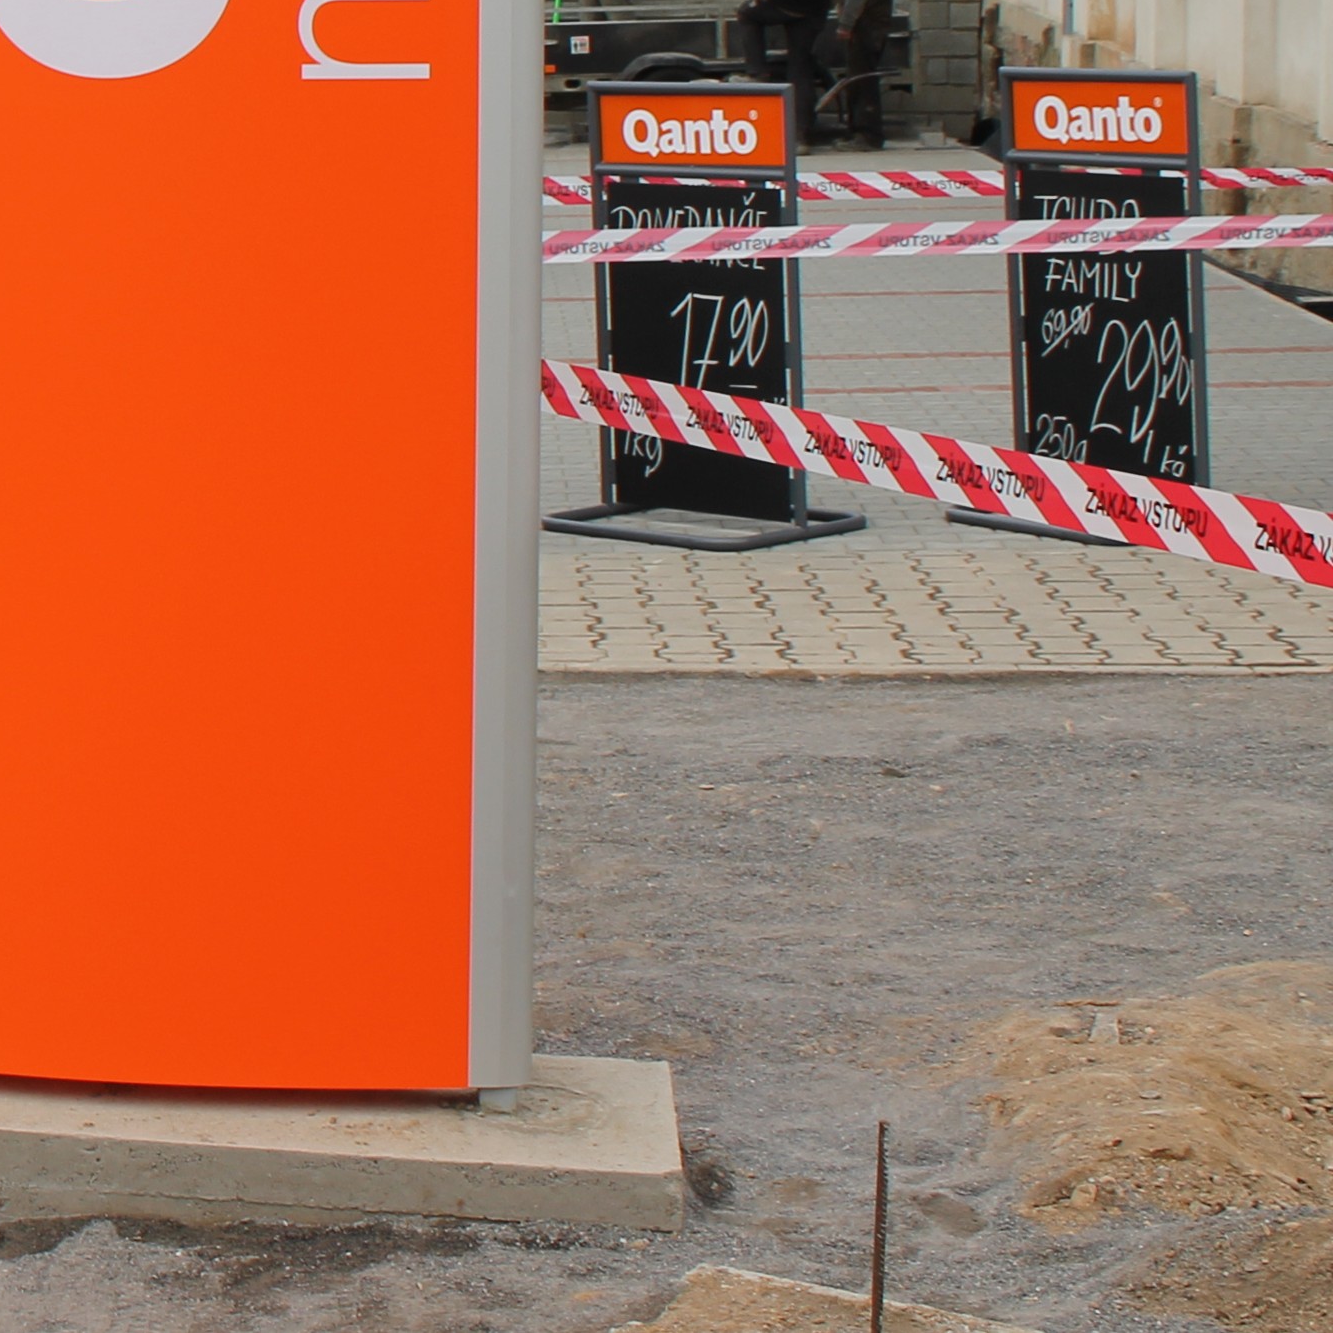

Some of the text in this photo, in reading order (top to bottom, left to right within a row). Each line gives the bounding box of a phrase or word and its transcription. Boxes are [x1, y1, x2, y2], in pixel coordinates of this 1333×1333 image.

[622, 109, 757, 157] Qanto
[1034, 95, 1163, 144] Qanto
[1045, 257, 1142, 303] FAMILY
[616, 391, 660, 420] VSTUPU
[726, 415, 774, 444] VSTUPU
[849, 438, 902, 471] VSTUPU
[986, 466, 1046, 502] VSTUPU
[1142, 498, 1209, 538] VSTUPU
[1254, 518, 1316, 561] ZÁKAZ
